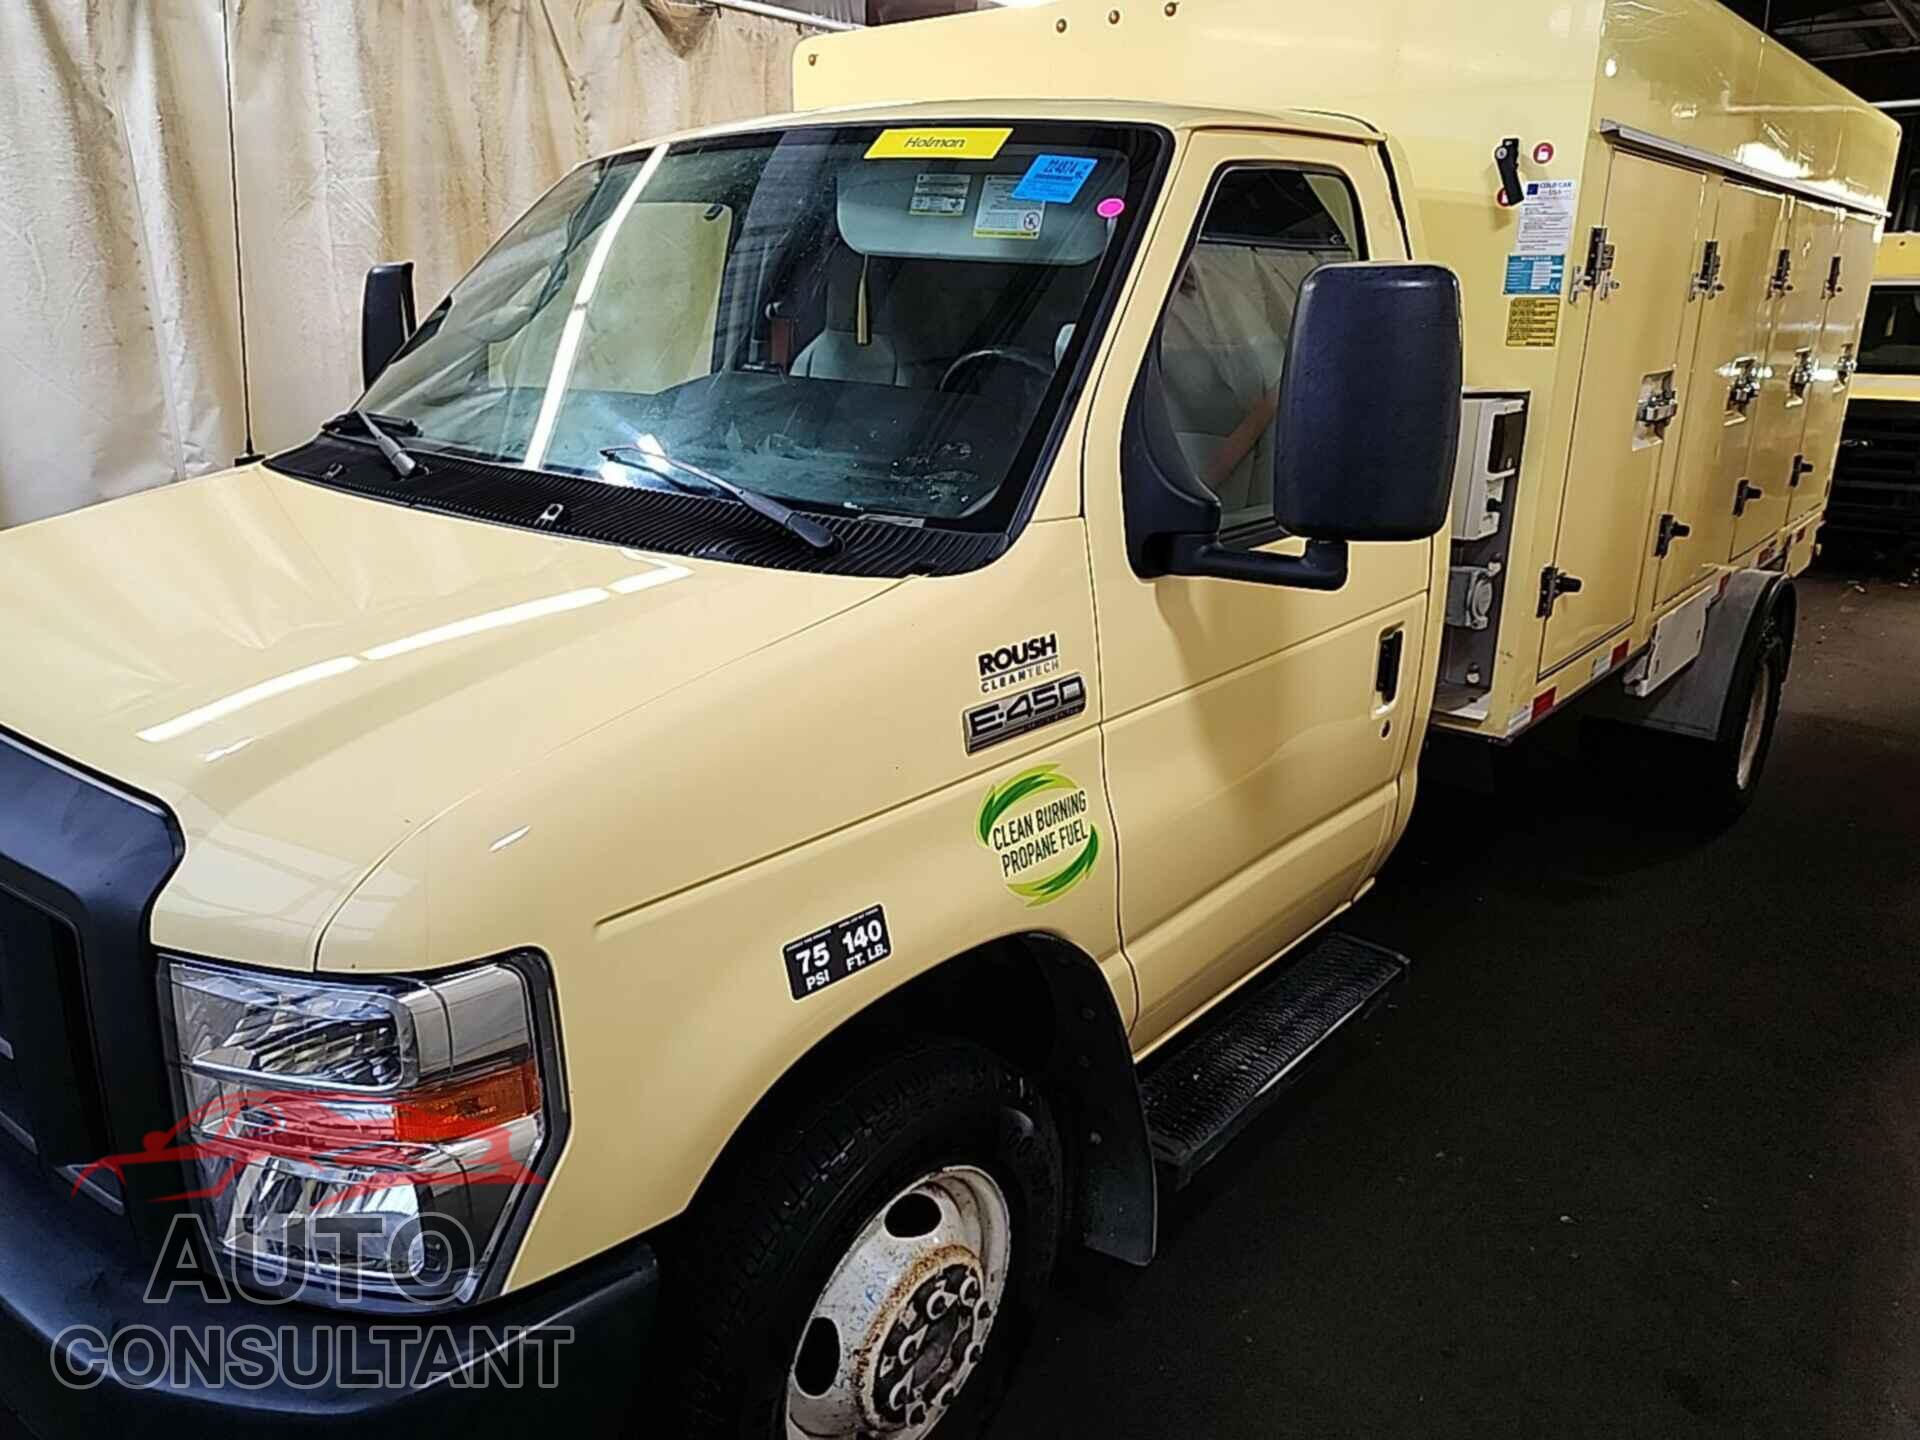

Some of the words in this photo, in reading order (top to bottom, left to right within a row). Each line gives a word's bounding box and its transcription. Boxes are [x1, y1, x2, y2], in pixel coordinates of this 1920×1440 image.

[904, 136, 965, 148] Holman
[978, 633, 1058, 676] ROUSH
[980, 659, 1060, 693] CLEANTECH
[992, 812, 1035, 852] CLEAN
[1035, 789, 1087, 831] BURNING
[1001, 831, 1060, 878] PROPANE
[1059, 817, 1089, 851] FUEL
[842, 919, 883, 954] 140
[795, 941, 830, 975] 75
[845, 952, 866, 971] FT.
[866, 943, 889, 961] LB.
[805, 969, 830, 991] PSI
